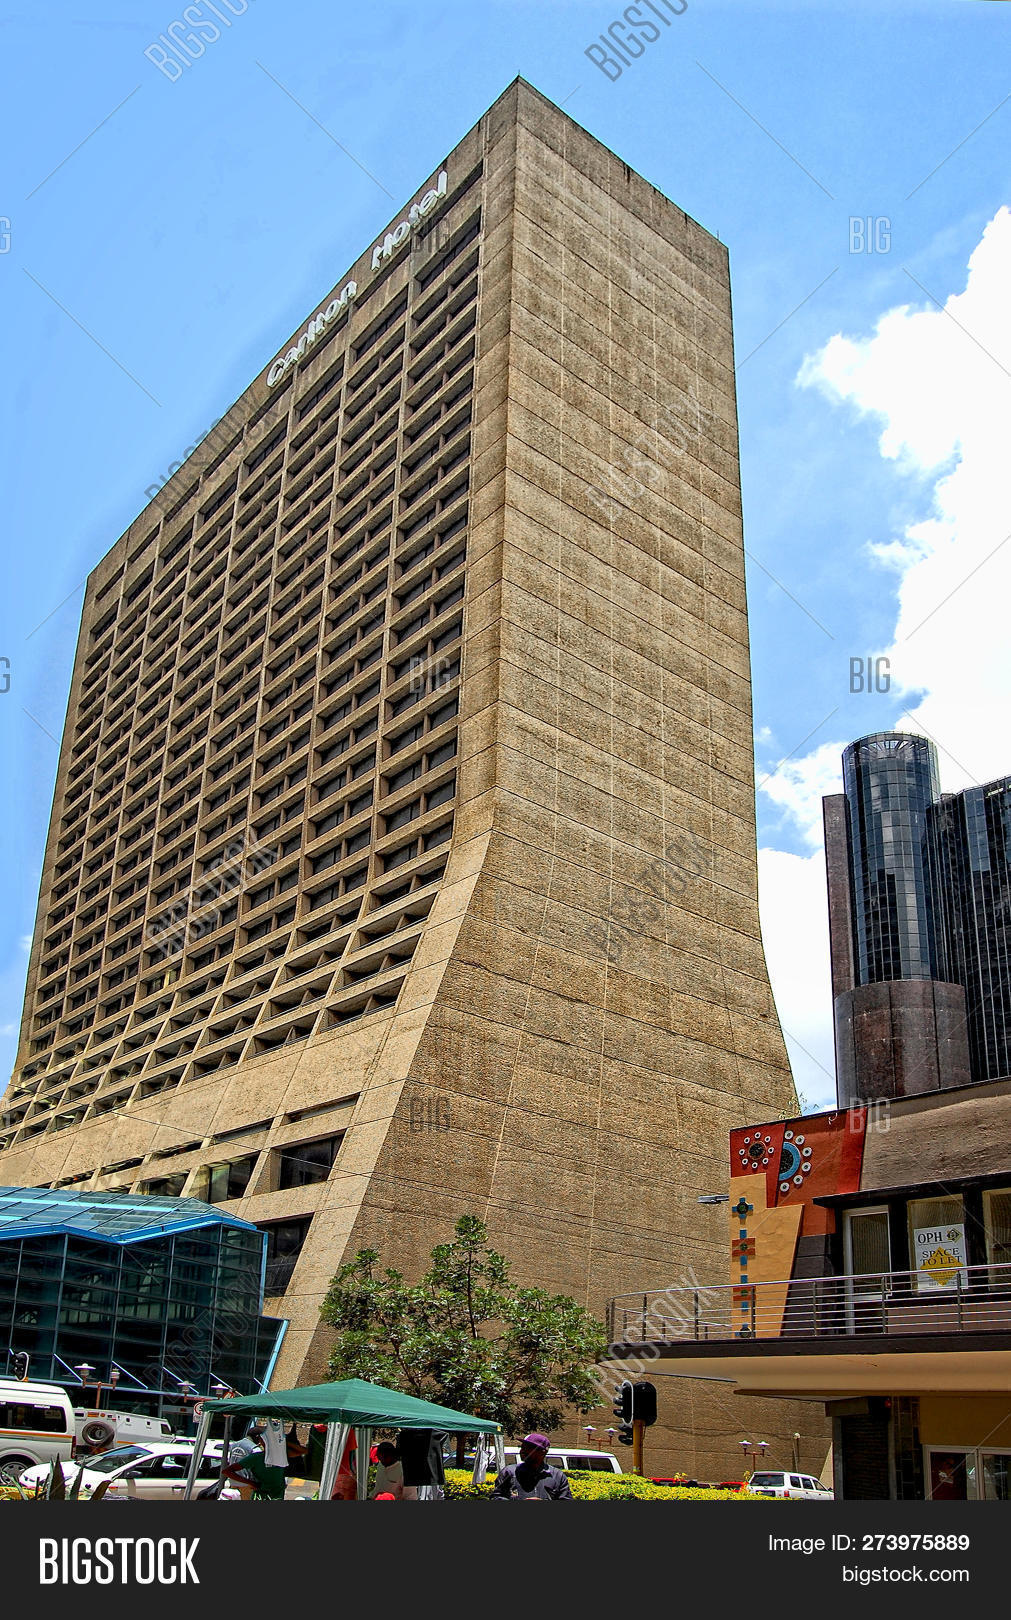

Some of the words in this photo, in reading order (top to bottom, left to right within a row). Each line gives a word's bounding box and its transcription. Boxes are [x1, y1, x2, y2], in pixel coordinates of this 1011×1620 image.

[266, 280, 358, 388] Carlton
[370, 170, 449, 272] Hotel
[917, 1231, 943, 1244] OPH
[922, 1247, 960, 1259] SPACE
[920, 1257, 937, 1266] TO
[940, 1255, 963, 1265] LET
